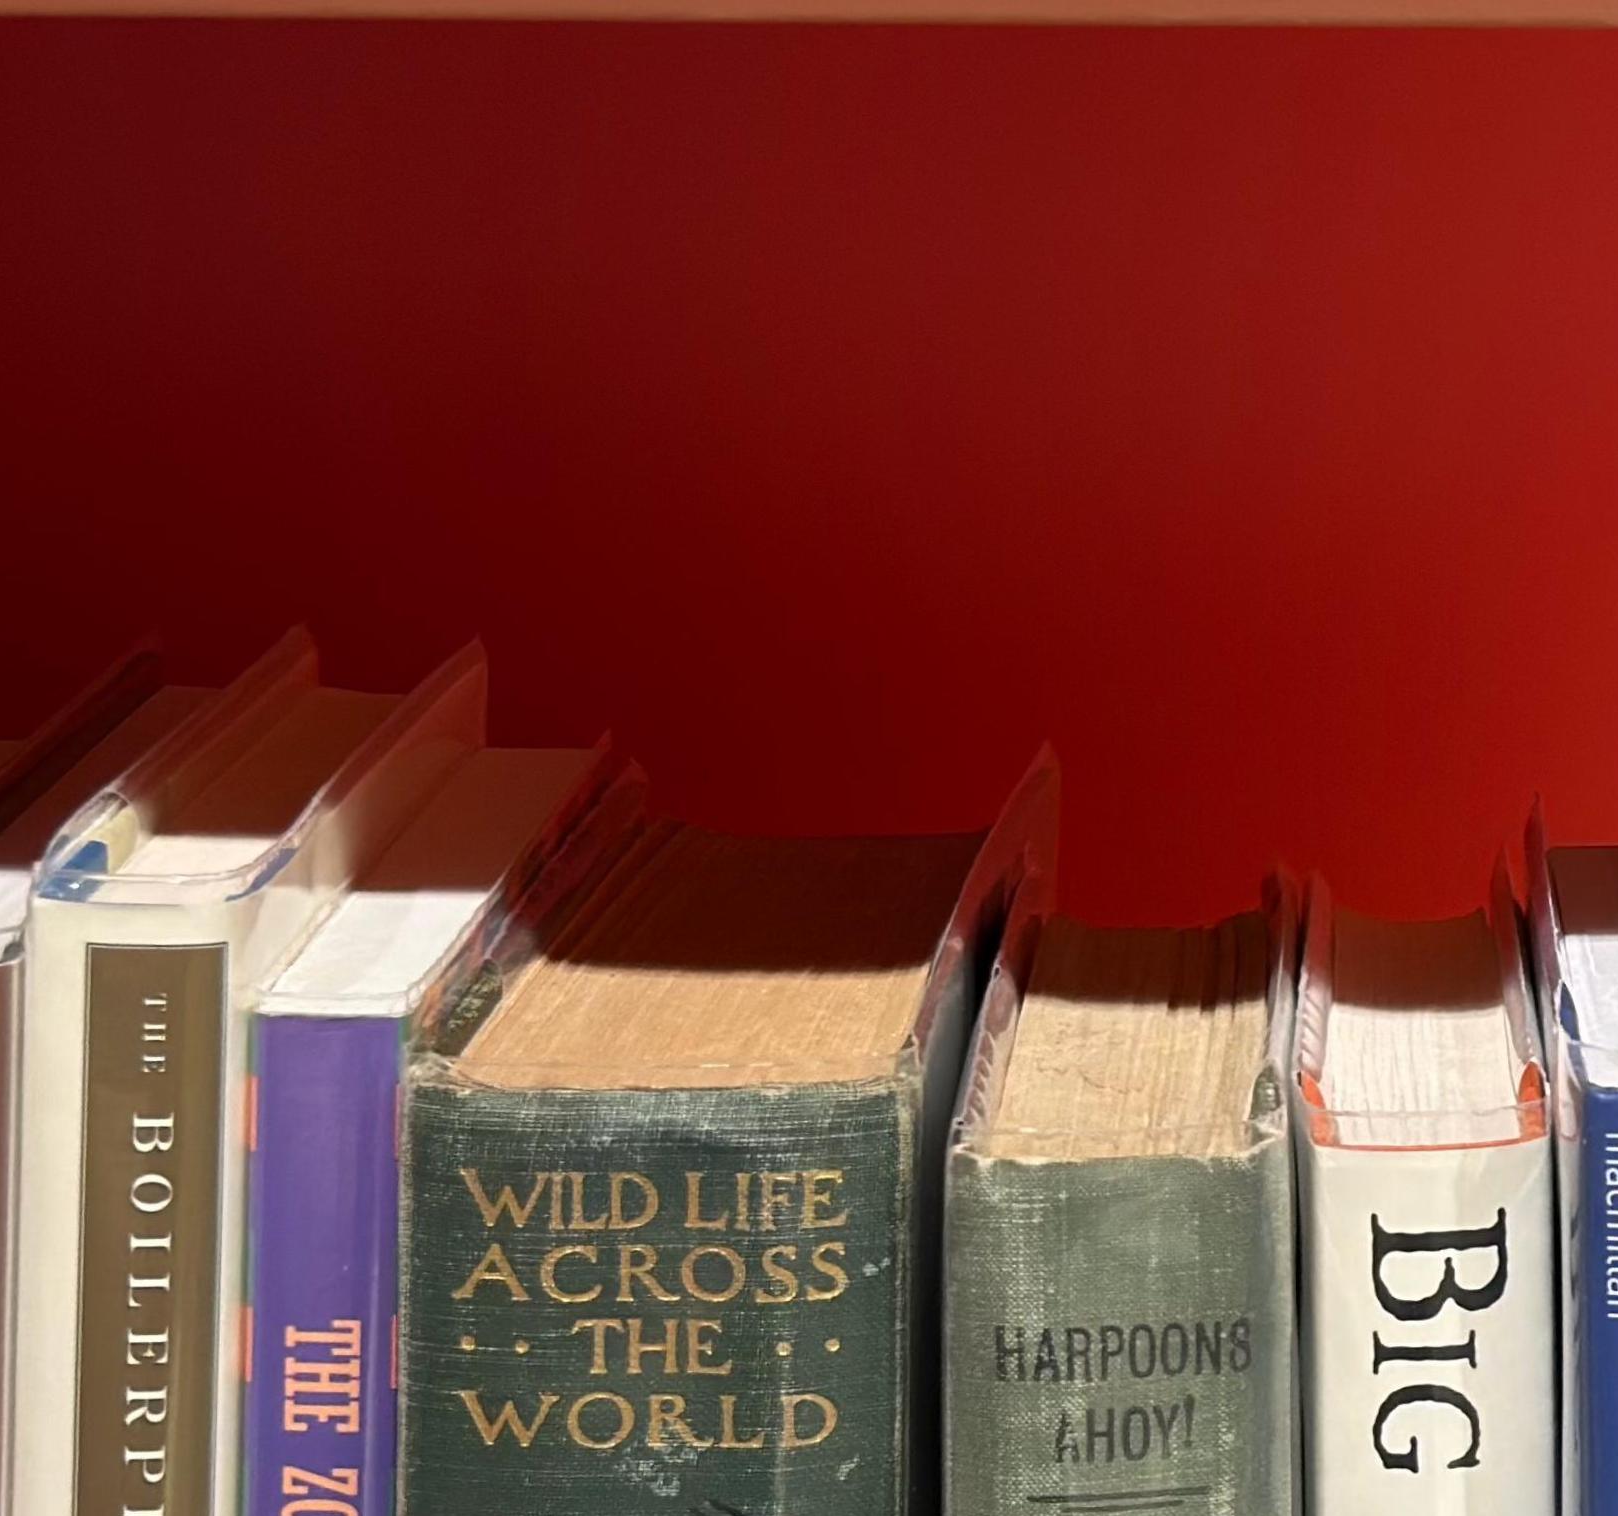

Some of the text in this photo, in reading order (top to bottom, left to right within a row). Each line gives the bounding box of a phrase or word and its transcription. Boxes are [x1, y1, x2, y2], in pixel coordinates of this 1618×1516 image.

[140, 991, 168, 1074] THE
[459, 1168, 851, 1232] WILD LIFE
[451, 1242, 851, 1304] ACROSS
[572, 1318, 733, 1376] THE
[993, 1317, 1253, 1383] HARPOONS
[1370, 1206, 1508, 1473] BIG
[284, 1319, 362, 1435] THE
[458, 1390, 839, 1449] WORLD
[1055, 1394, 1195, 1463] AHOY!
